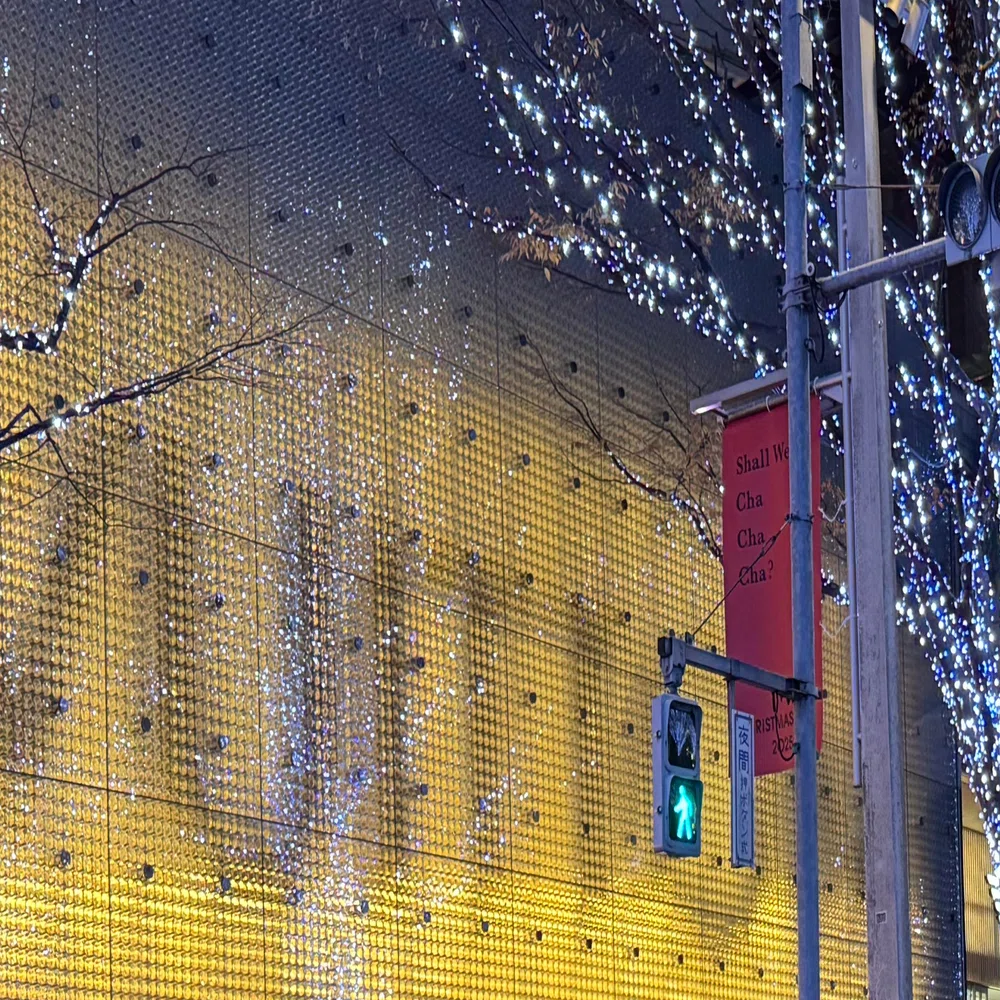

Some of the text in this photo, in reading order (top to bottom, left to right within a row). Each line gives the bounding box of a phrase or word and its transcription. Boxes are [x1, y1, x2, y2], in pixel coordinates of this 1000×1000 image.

[736, 441, 790, 475] Shall We
[736, 490, 763, 512] Cha
[737, 528, 765, 549] Cha
[739, 559, 774, 586] Cha?
[755, 710, 794, 734] RISTMAS
